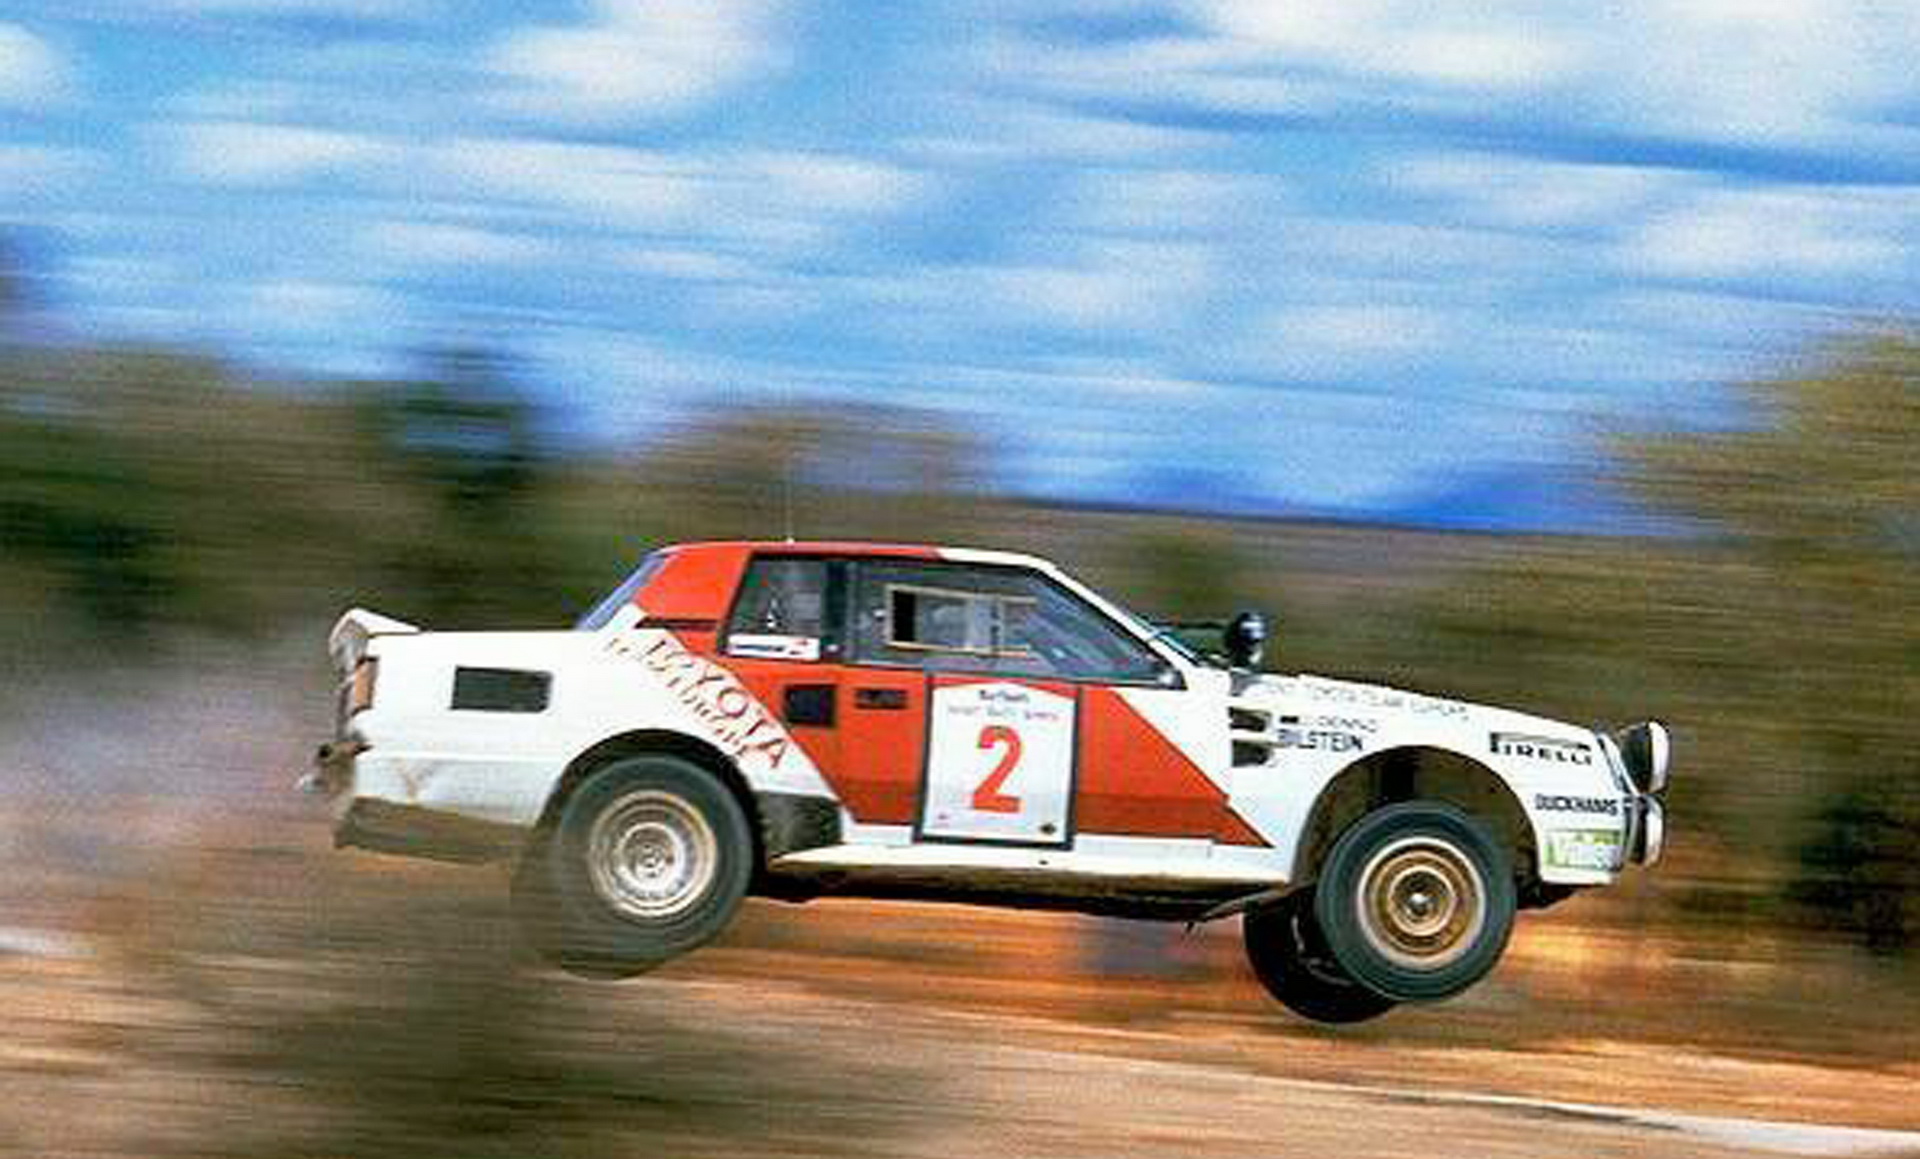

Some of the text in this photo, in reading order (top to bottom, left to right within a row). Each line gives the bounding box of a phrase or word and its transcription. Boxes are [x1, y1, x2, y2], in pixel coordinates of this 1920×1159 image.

[1277, 729, 1364, 752] BILSTEIN
[1490, 731, 1592, 766] PIRELLI
[973, 724, 1023, 814] 2
[1535, 794, 1619, 816] DUCKHAMS
